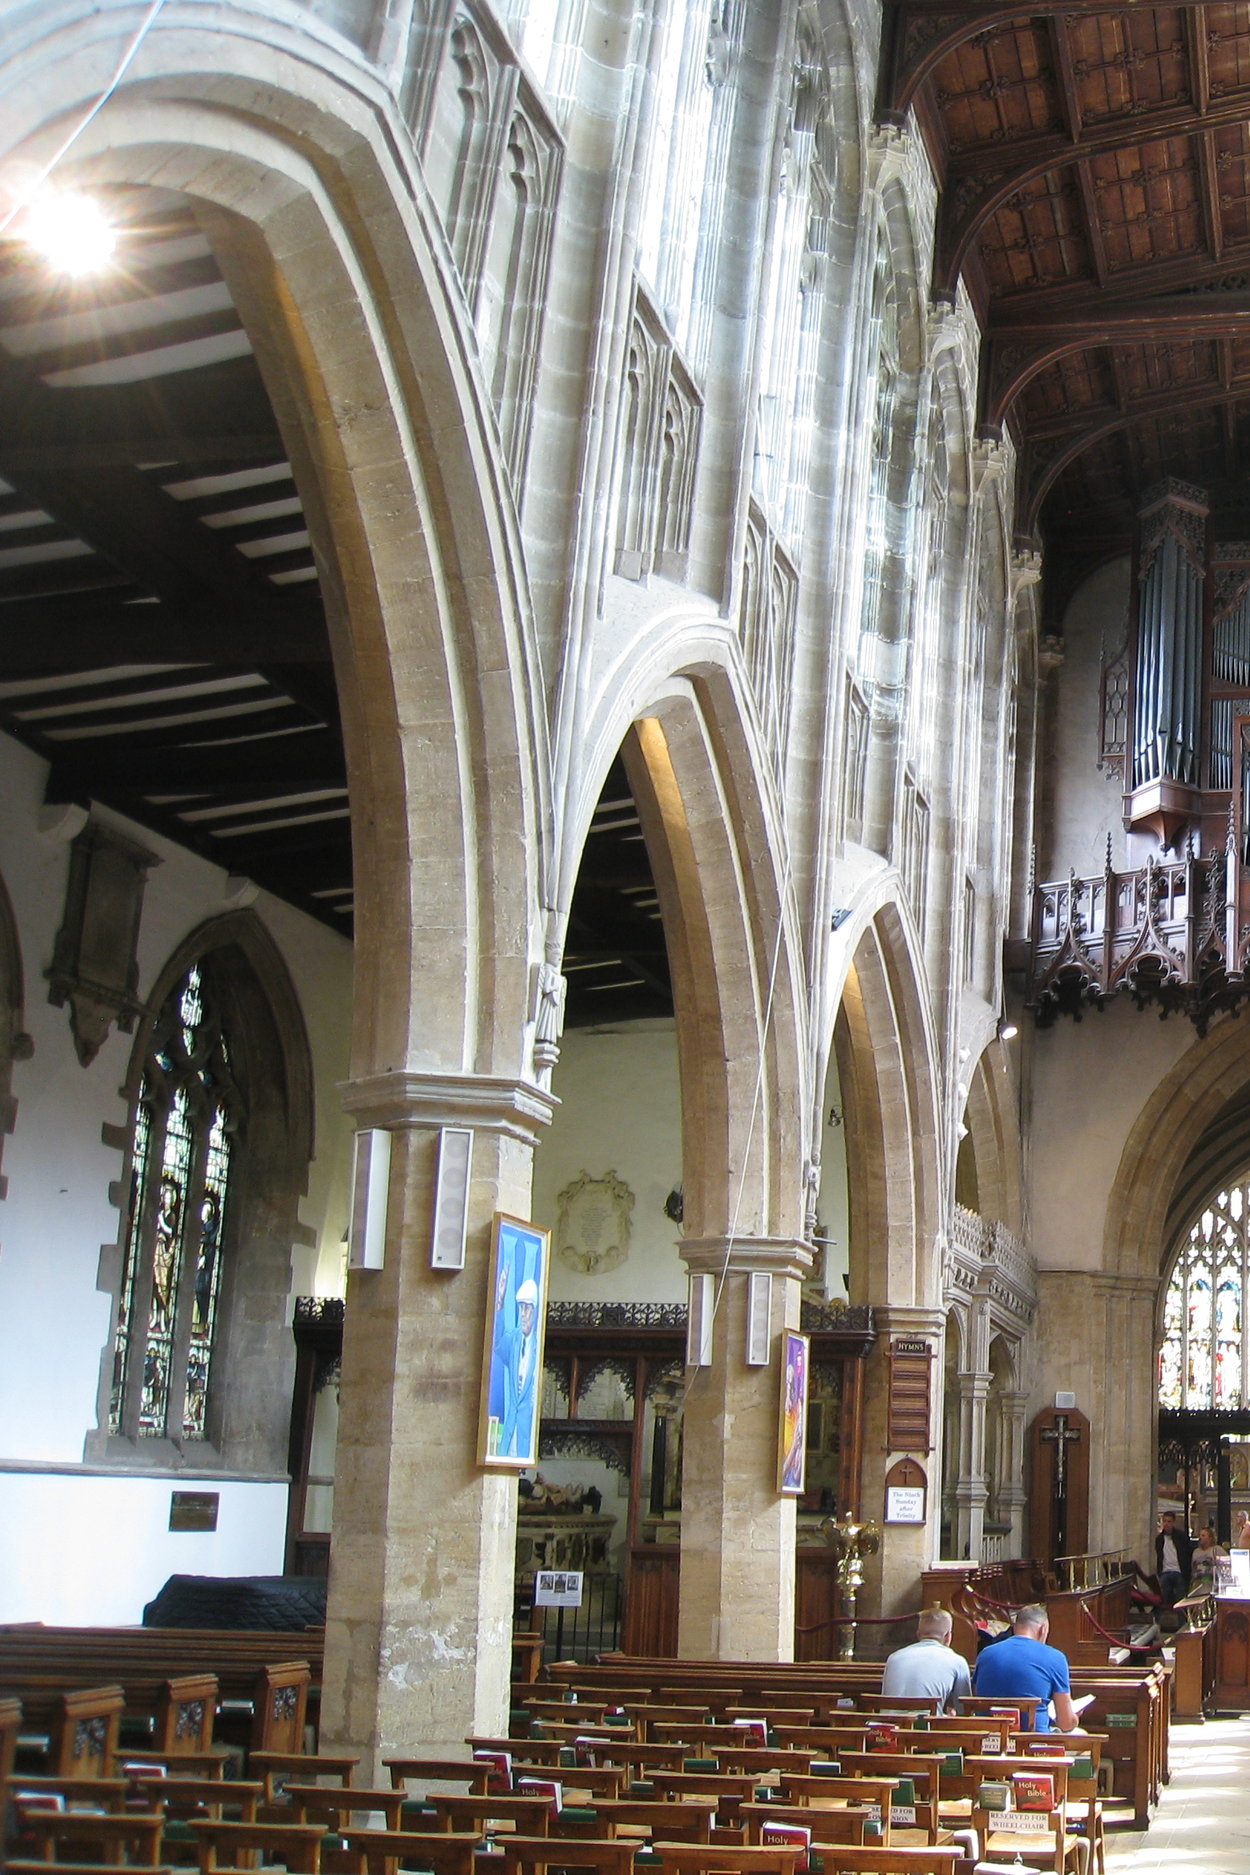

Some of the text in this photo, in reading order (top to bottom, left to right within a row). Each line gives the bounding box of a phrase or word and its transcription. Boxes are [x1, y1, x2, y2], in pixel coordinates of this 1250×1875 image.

[1019, 1782, 1036, 1790] Holy
[522, 1788, 540, 1796] Holy
[1027, 1789, 1047, 1797] Bible
[991, 1812, 1030, 1820] RESERVED
[992, 1821, 1045, 1829] WHEELCHAIR
[767, 1835, 789, 1845] Holy
